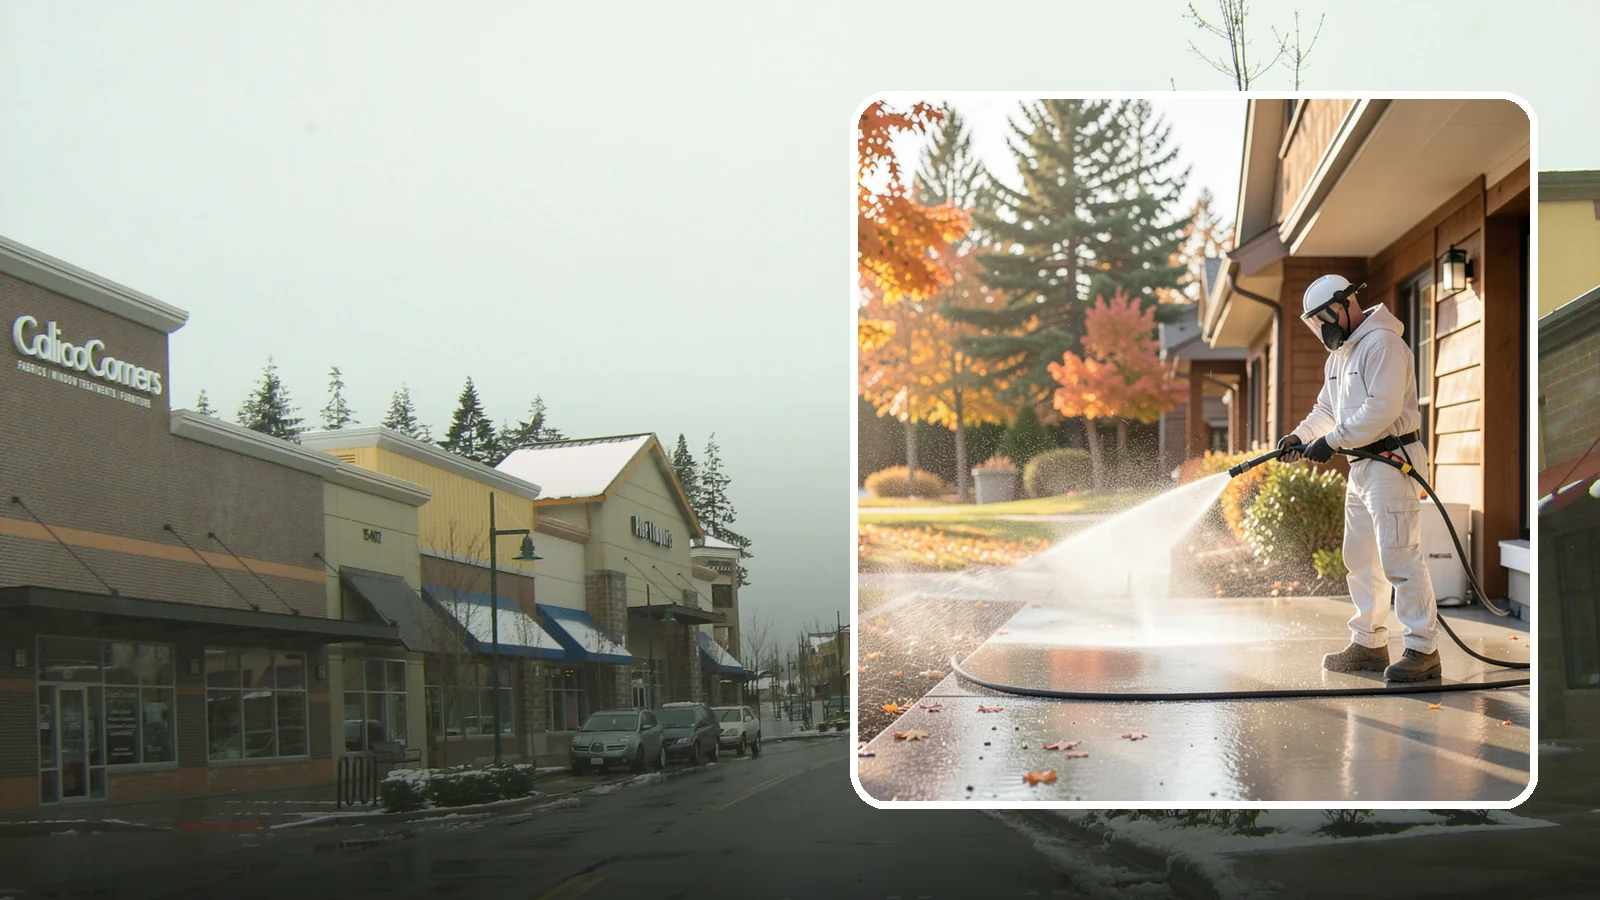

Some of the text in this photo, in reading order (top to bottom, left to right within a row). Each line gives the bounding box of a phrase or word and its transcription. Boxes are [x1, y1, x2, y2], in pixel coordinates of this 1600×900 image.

[12, 315, 162, 396] CalicoCorners
[16, 359, 47, 378] FABRICS
[51, 370, 78, 387] WINDOW
[78, 379, 117, 398] TREATMENTS
